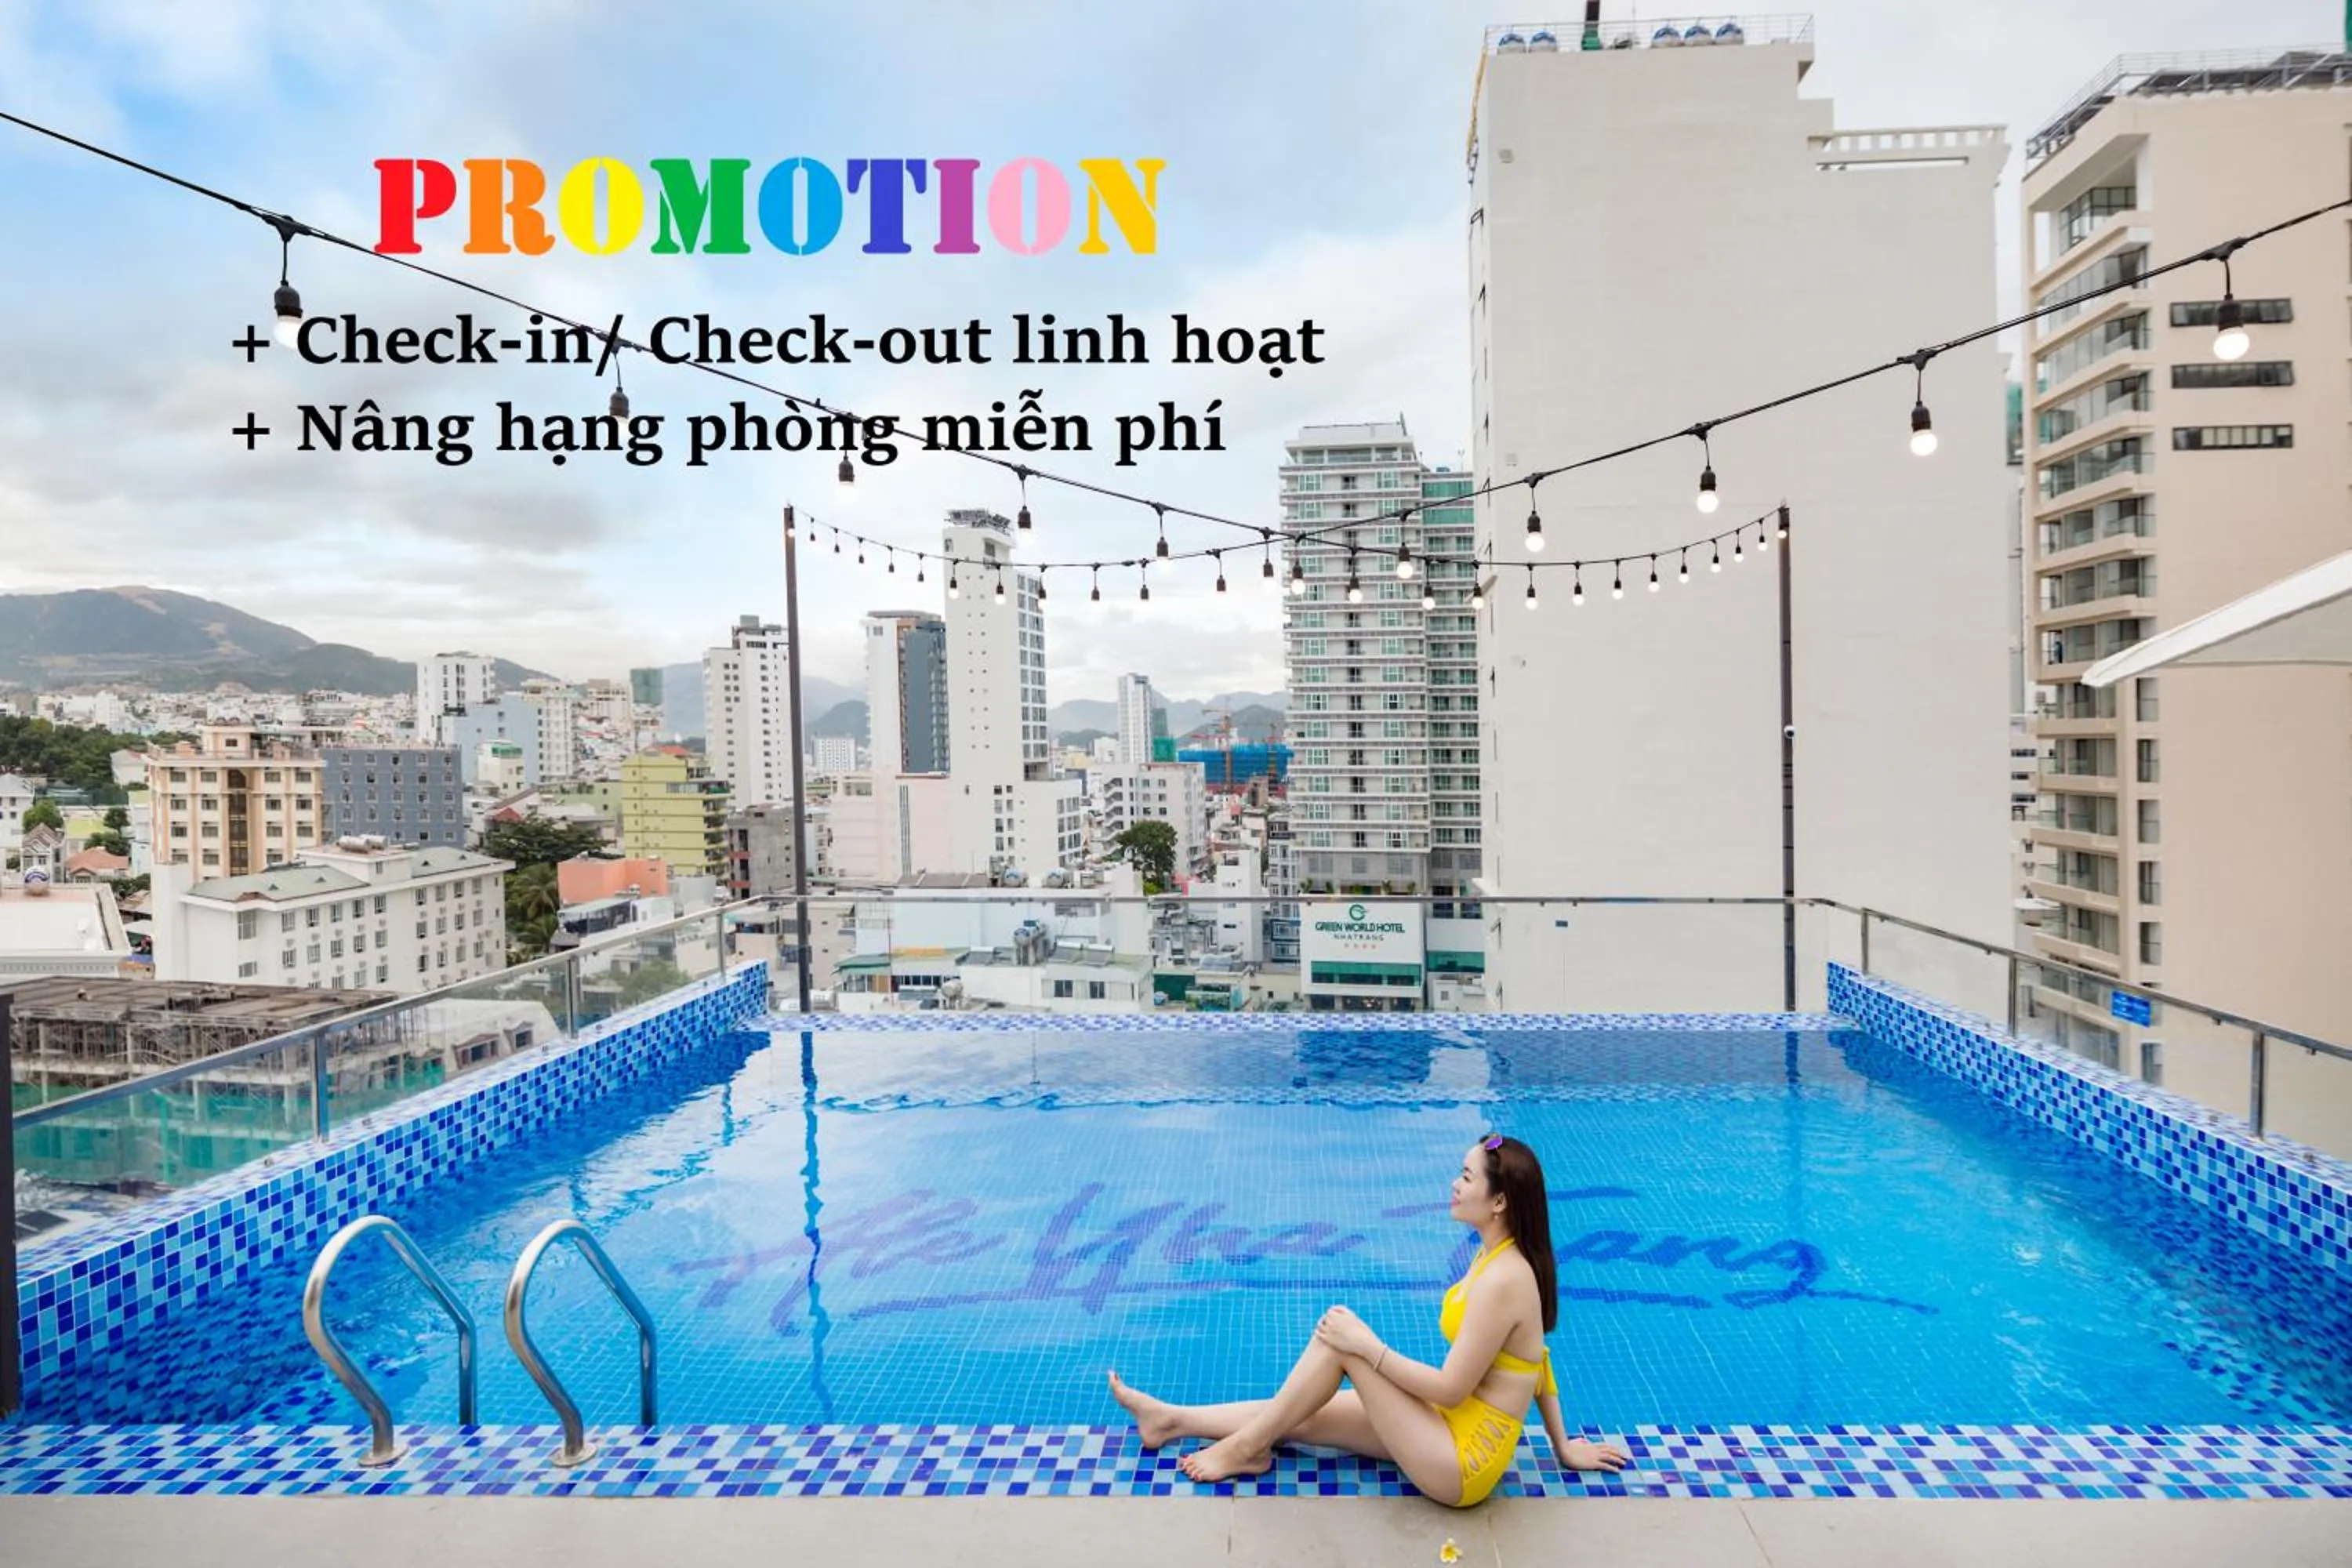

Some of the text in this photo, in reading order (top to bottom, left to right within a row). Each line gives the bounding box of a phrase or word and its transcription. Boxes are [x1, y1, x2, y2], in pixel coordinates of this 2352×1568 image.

[1316, 921, 1405, 933] GREEN WORLD HOTEL
